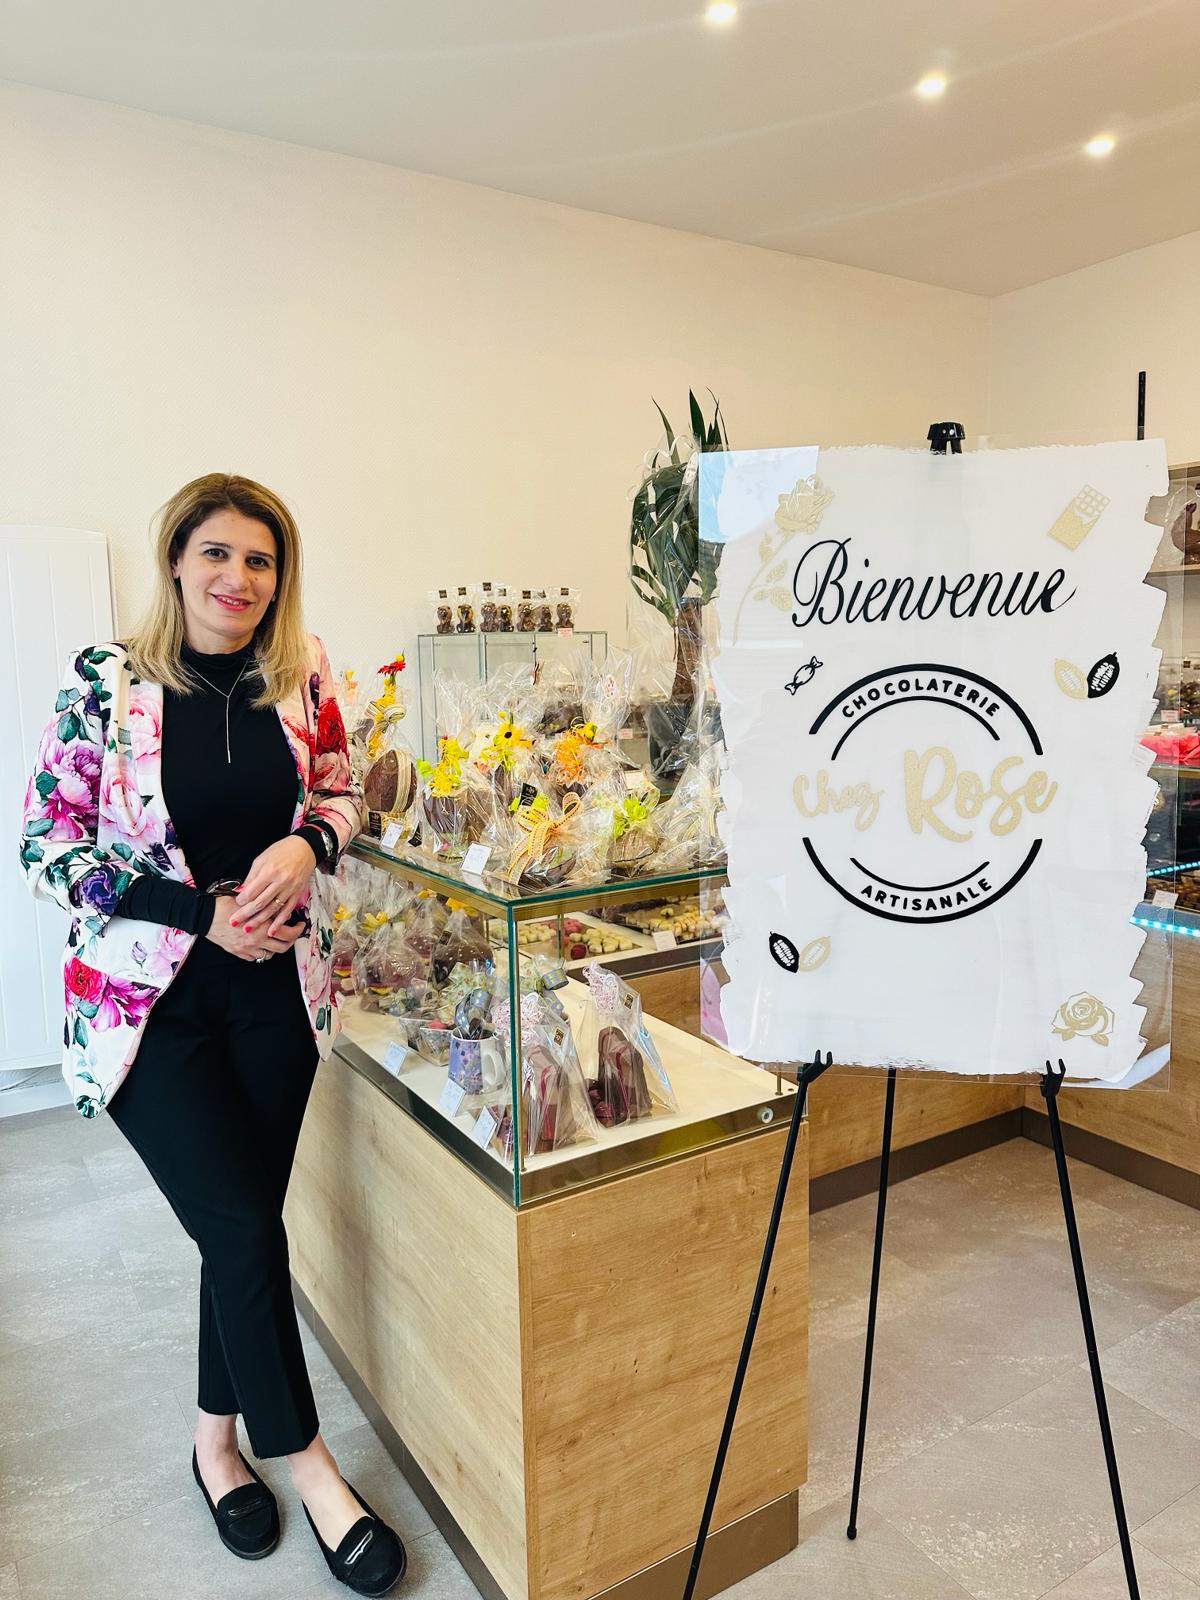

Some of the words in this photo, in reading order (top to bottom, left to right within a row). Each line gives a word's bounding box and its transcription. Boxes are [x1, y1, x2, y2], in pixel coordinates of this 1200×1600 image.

[792, 538, 1077, 627] Bienvenue
[842, 678, 1000, 718] CHOCOLATERIE
[792, 768, 885, 832] Chez
[904, 746, 1058, 843] Rose
[861, 878, 992, 911] ARTISANALE
